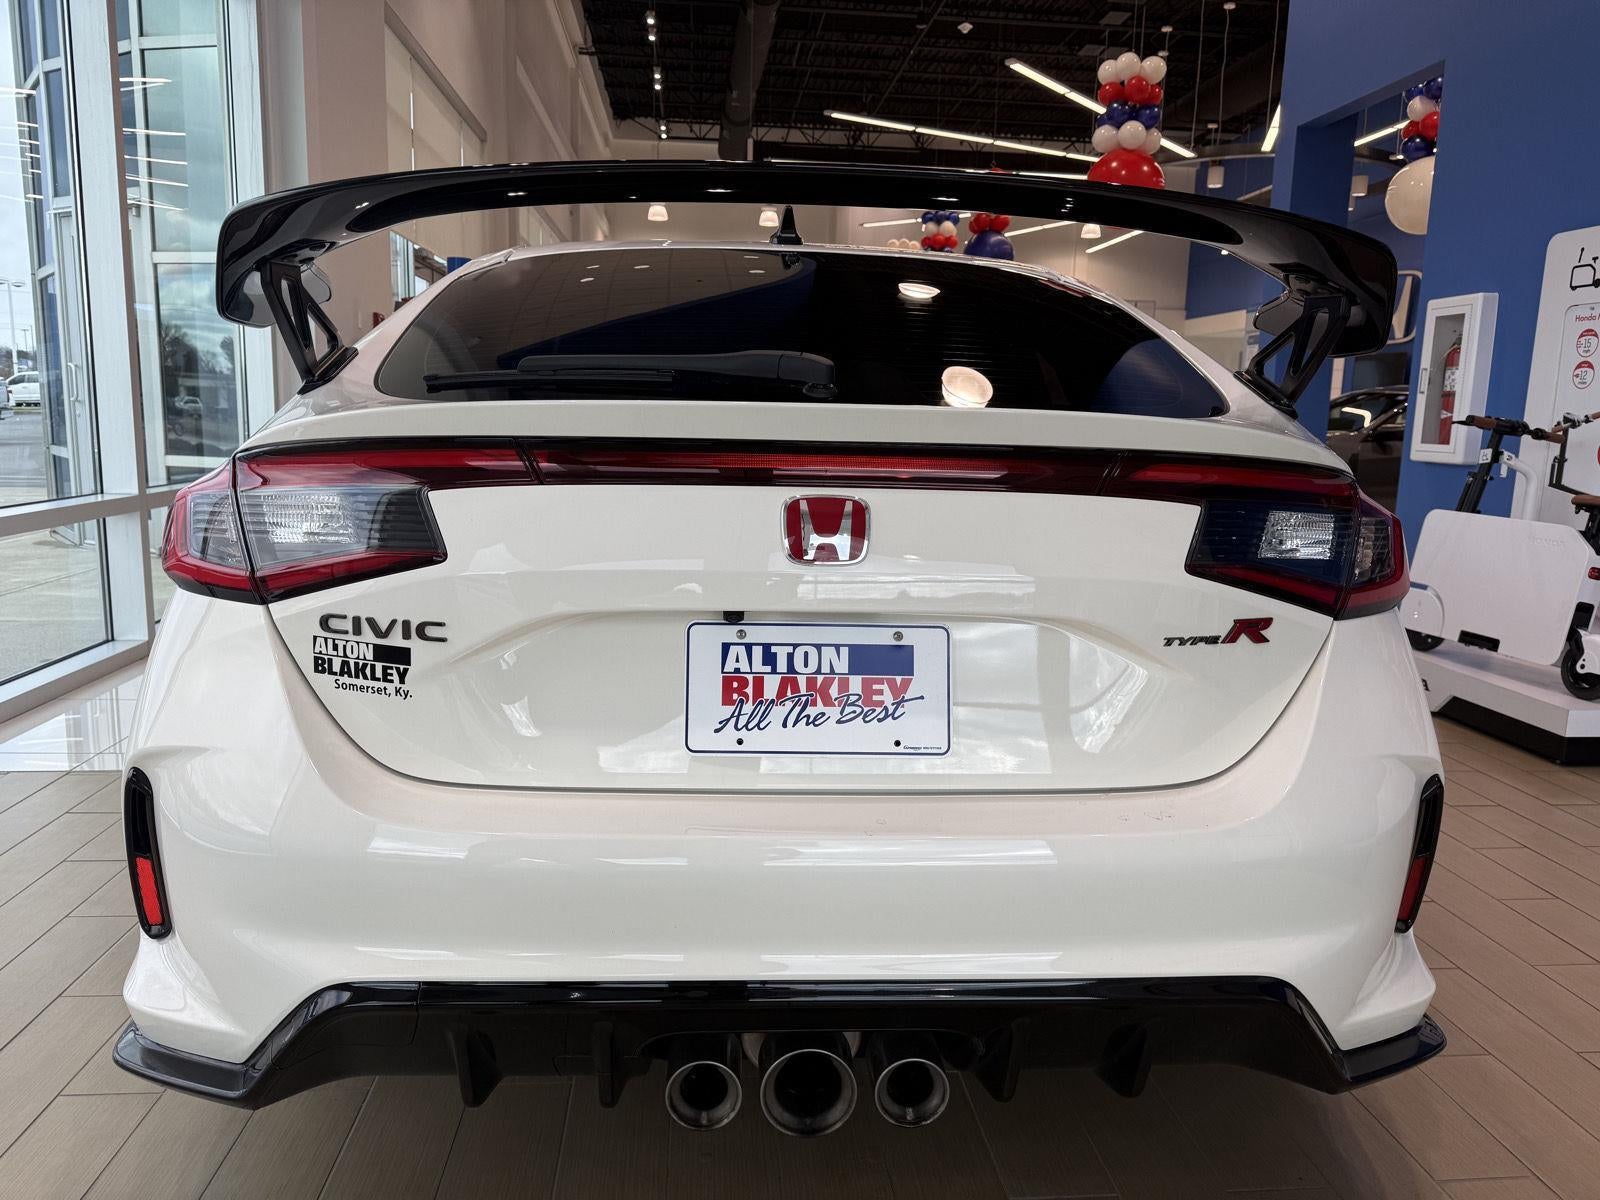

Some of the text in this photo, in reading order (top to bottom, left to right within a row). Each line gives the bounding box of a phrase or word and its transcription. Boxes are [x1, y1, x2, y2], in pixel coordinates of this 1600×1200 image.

[1575, 313, 1596, 322] Honda
[1584, 338, 1591, 348] 15
[1580, 370, 1587, 380] 12
[319, 613, 448, 642] CIVIC
[1163, 617, 1274, 647] TYPE R
[314, 636, 374, 661] ALTON
[723, 645, 850, 674] ALTON
[313, 655, 410, 685] BLAKLEY
[334, 678, 413, 700] Somerset, Ky.
[721, 675, 913, 708] BLAKLEY
[713, 692, 925, 734] All The Best
